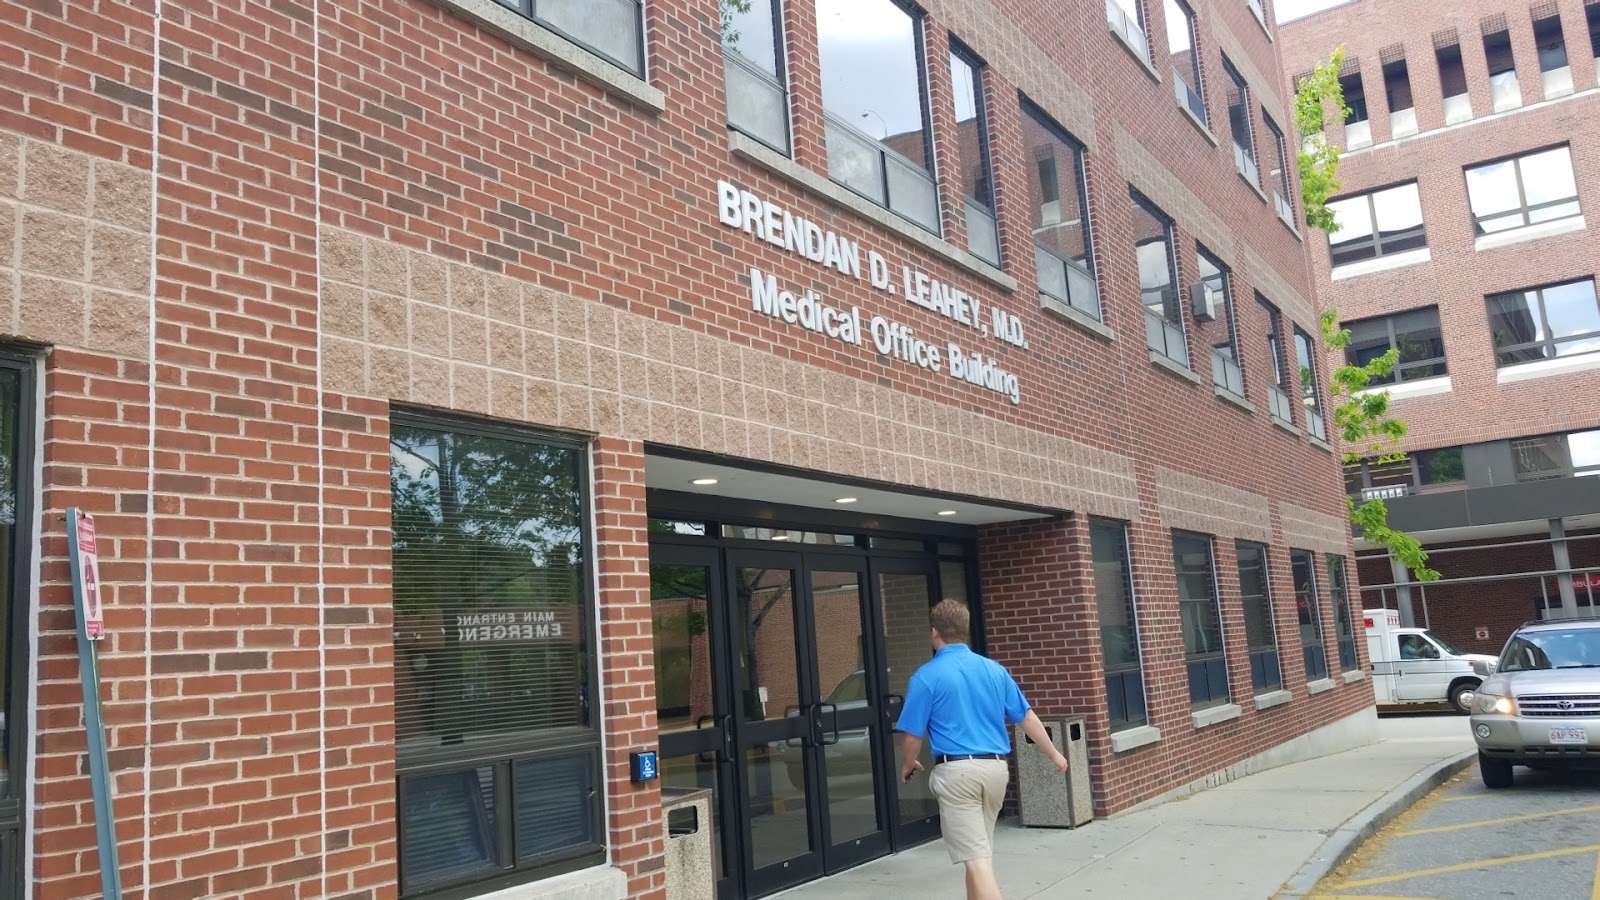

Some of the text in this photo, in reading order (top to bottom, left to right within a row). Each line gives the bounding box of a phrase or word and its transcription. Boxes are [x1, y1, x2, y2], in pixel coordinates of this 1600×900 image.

[717, 180, 1029, 349] BRENDAN D. LEAHEY, M.D.
[750, 268, 1019, 405] Medical Office Building
